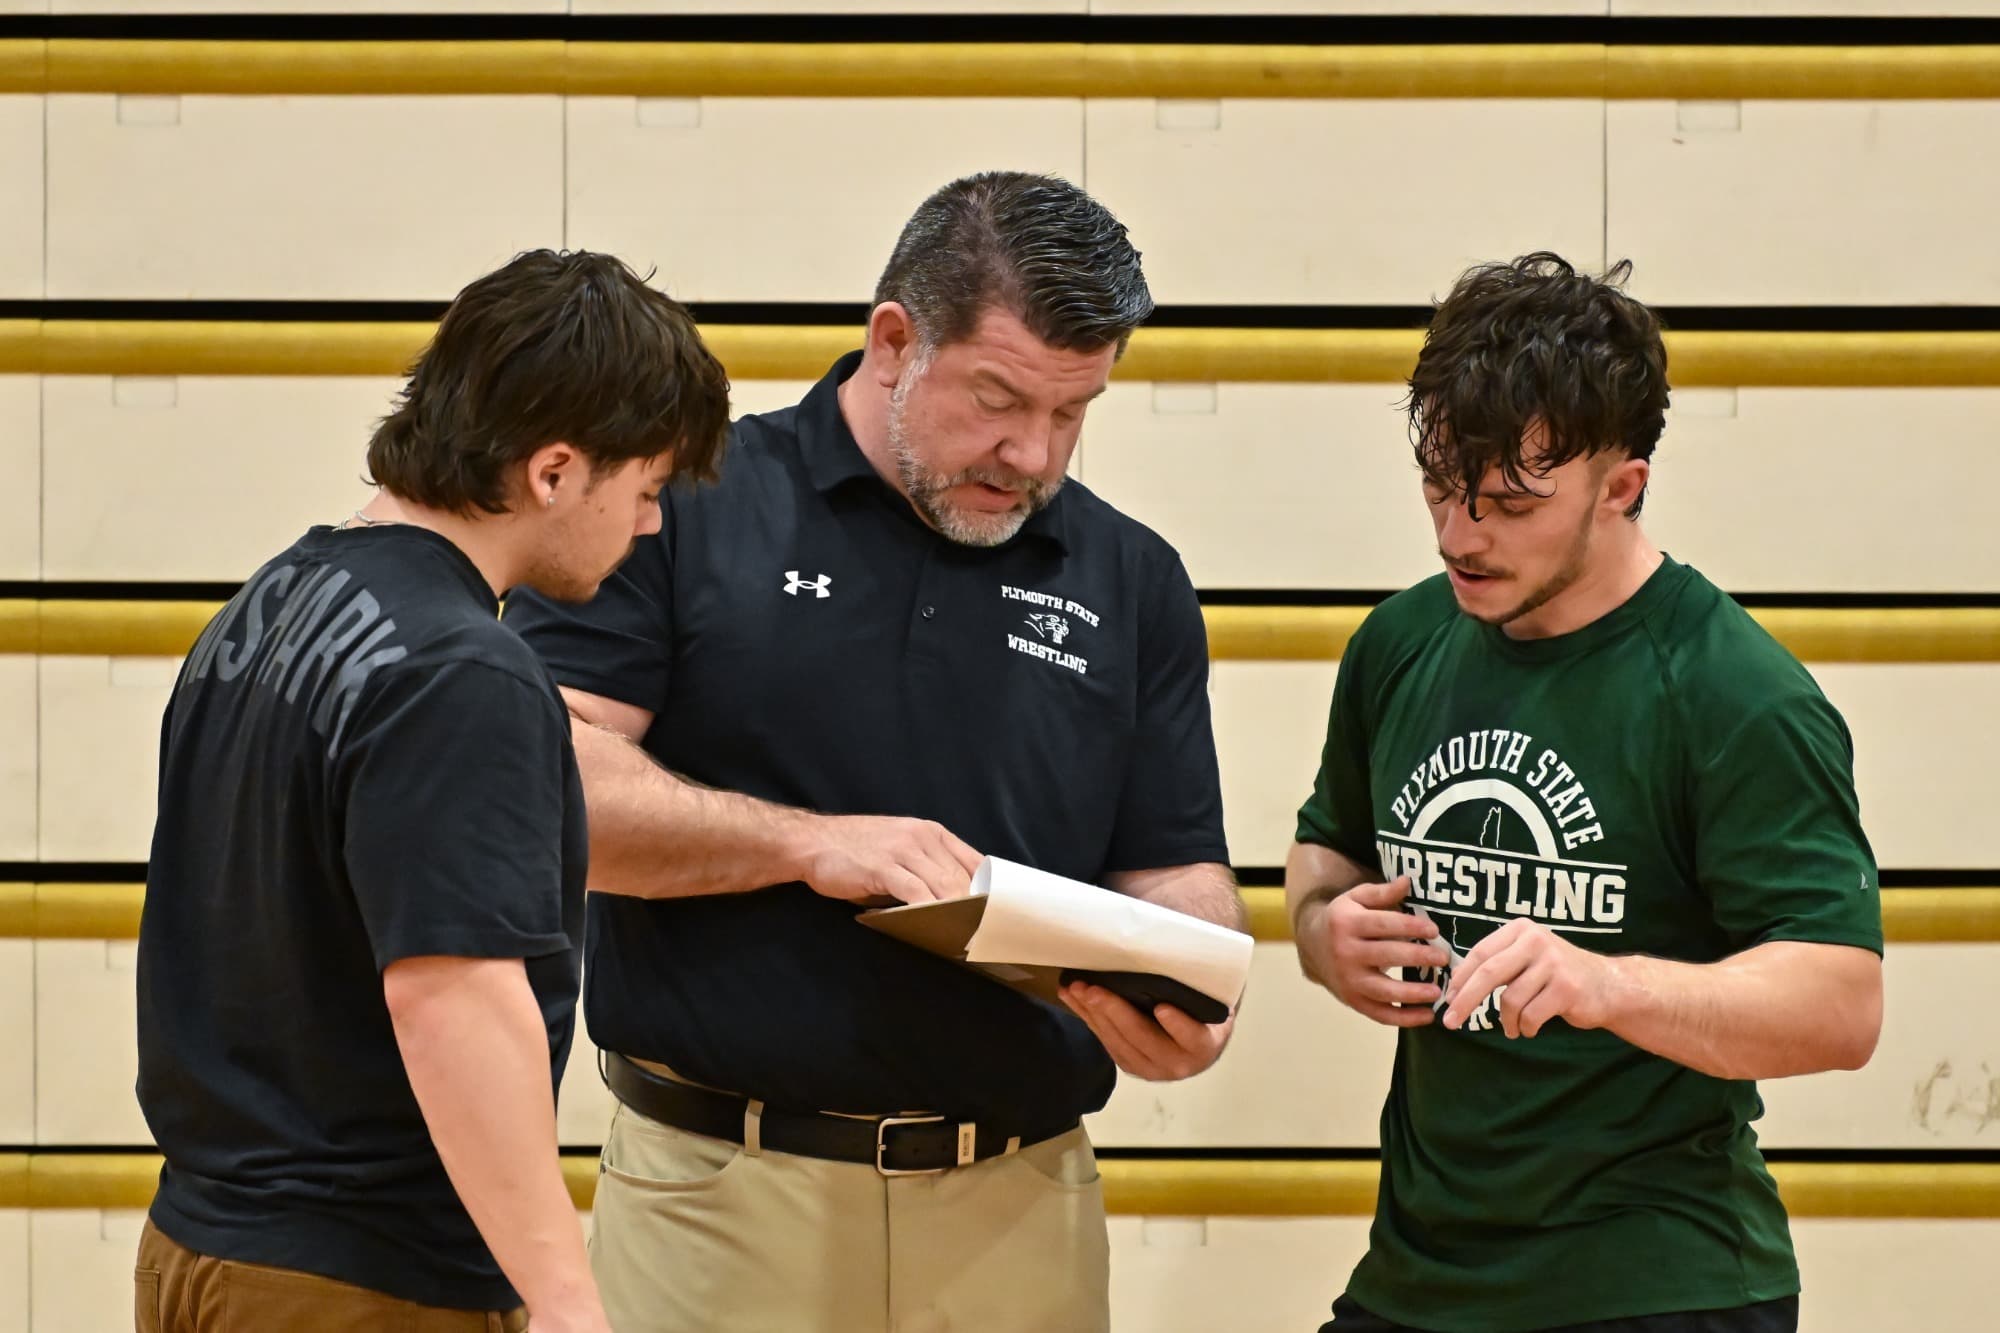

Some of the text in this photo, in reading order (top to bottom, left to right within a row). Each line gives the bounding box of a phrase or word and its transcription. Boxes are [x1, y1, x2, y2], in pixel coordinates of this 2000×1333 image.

[1001, 585, 1100, 628] PLYMOUTH STATE
[1007, 633, 1088, 674] WRESTLING
[1391, 729, 1604, 850] PLYMOUTH STATE
[1376, 840, 1627, 923] WRESTLING
